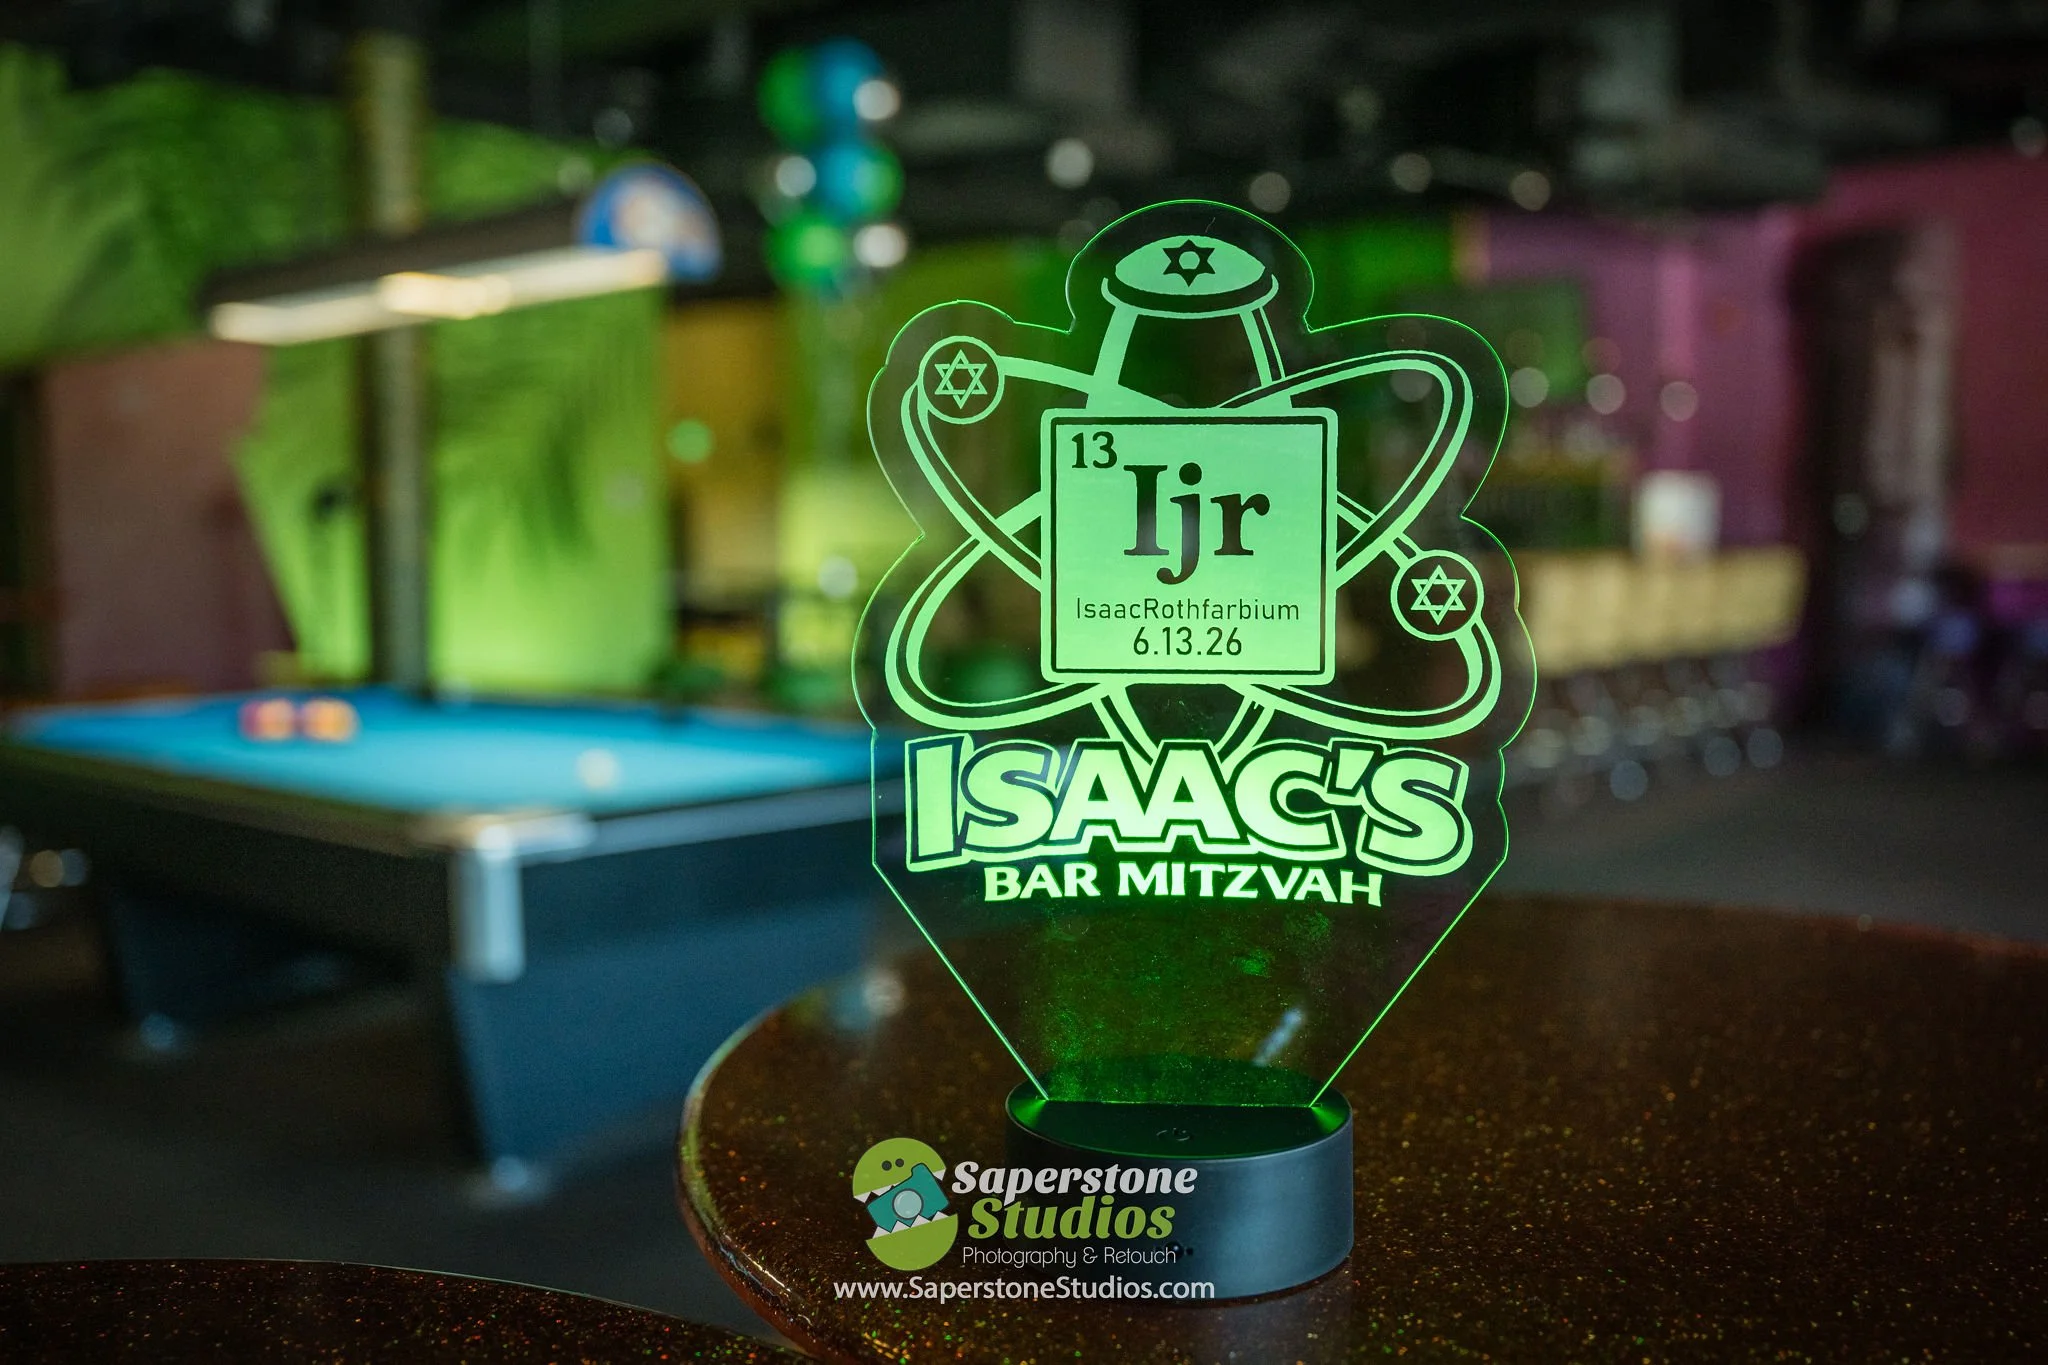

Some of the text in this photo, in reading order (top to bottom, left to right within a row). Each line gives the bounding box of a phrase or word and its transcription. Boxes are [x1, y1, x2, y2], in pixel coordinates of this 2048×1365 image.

[1071, 431, 1118, 469] 13
[1123, 462, 1270, 585] Ijr
[1076, 598, 1300, 620] IsaacRothfarbium
[1133, 627, 1242, 655] 6.13.26
[905, 734, 1474, 875] ISAAC'S
[984, 861, 1382, 907] BAR MITZVAH
